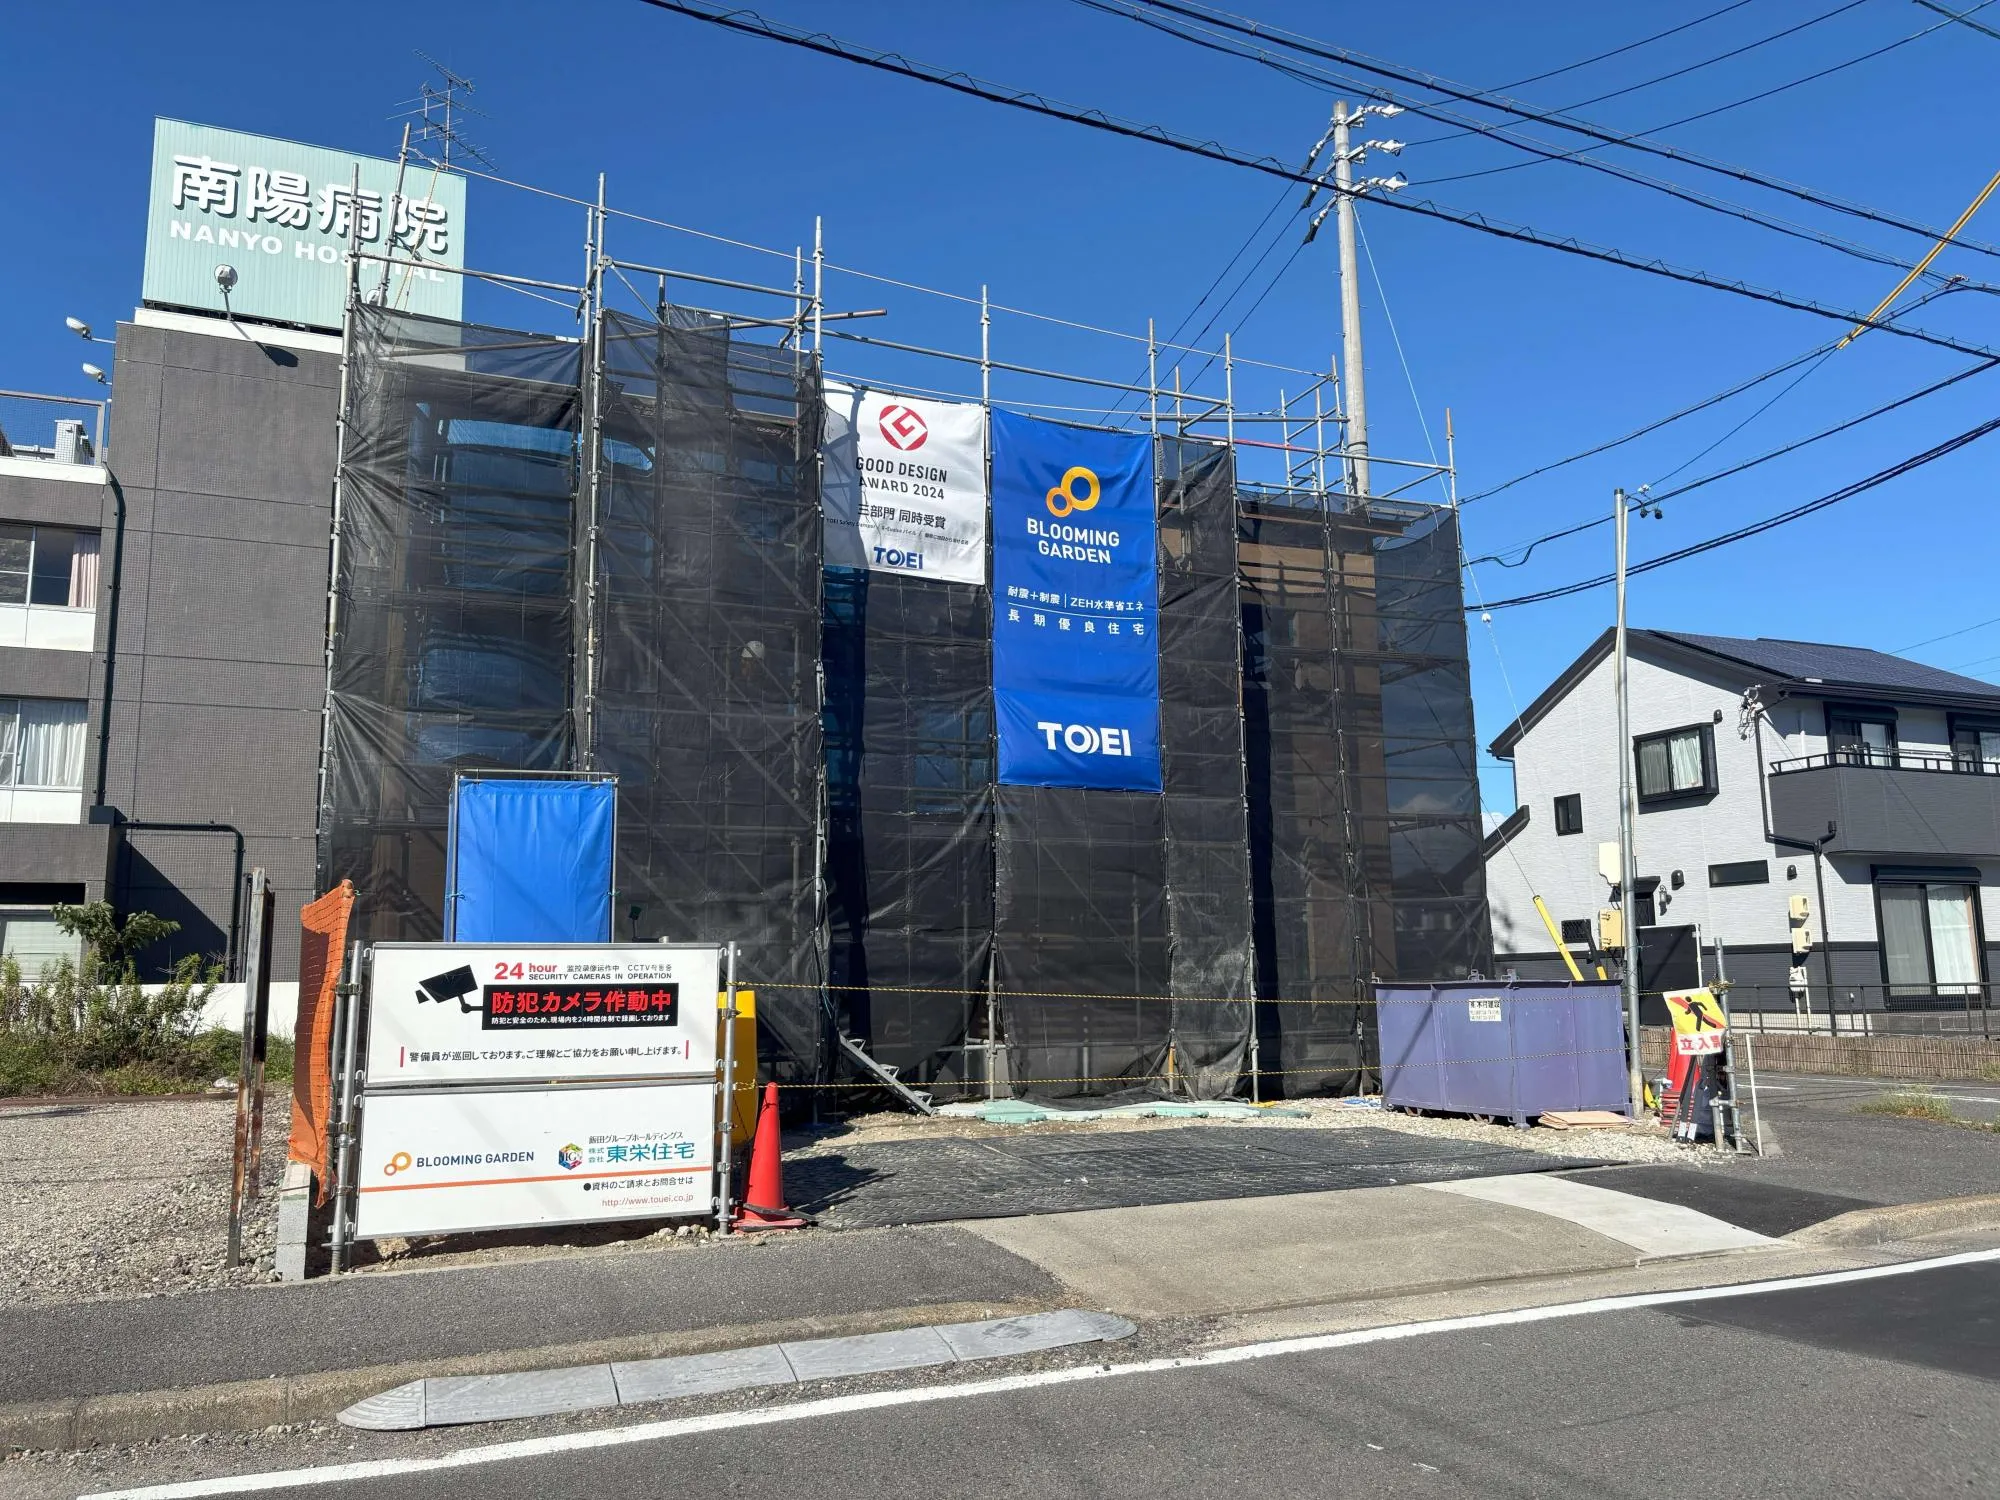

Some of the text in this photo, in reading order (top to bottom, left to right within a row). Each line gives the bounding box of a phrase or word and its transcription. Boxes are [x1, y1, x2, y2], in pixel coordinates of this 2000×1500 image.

[172, 156, 449, 256] 南陽病院
[170, 220, 282, 255] NANYO
[855, 456, 948, 483] GOOD DESIGN
[858, 476, 945, 500] AWARD 2024
[857, 503, 895, 521] 三部門
[898, 509, 947, 530] 同時受賞
[1027, 517, 1121, 547] BLOOMING
[1038, 540, 1112, 564] GARDEN
[1070, 596, 1144, 612] ZEH水準省エネ
[494, 962, 525, 980] 24
[528, 963, 558, 973] hour
[528, 973, 569, 981] SECURITY
[627, 972, 673, 980] OPERATION
[491, 989, 672, 1014] 防犯カメラ作動中
[588, 1131, 684, 1144] 飯田グループホールディングス
[416, 1151, 535, 1168] BLOOMING GARDEN
[606, 1141, 695, 1163] 東栄住宅
[602, 1194, 694, 1207] http://www.touei.co.jp
